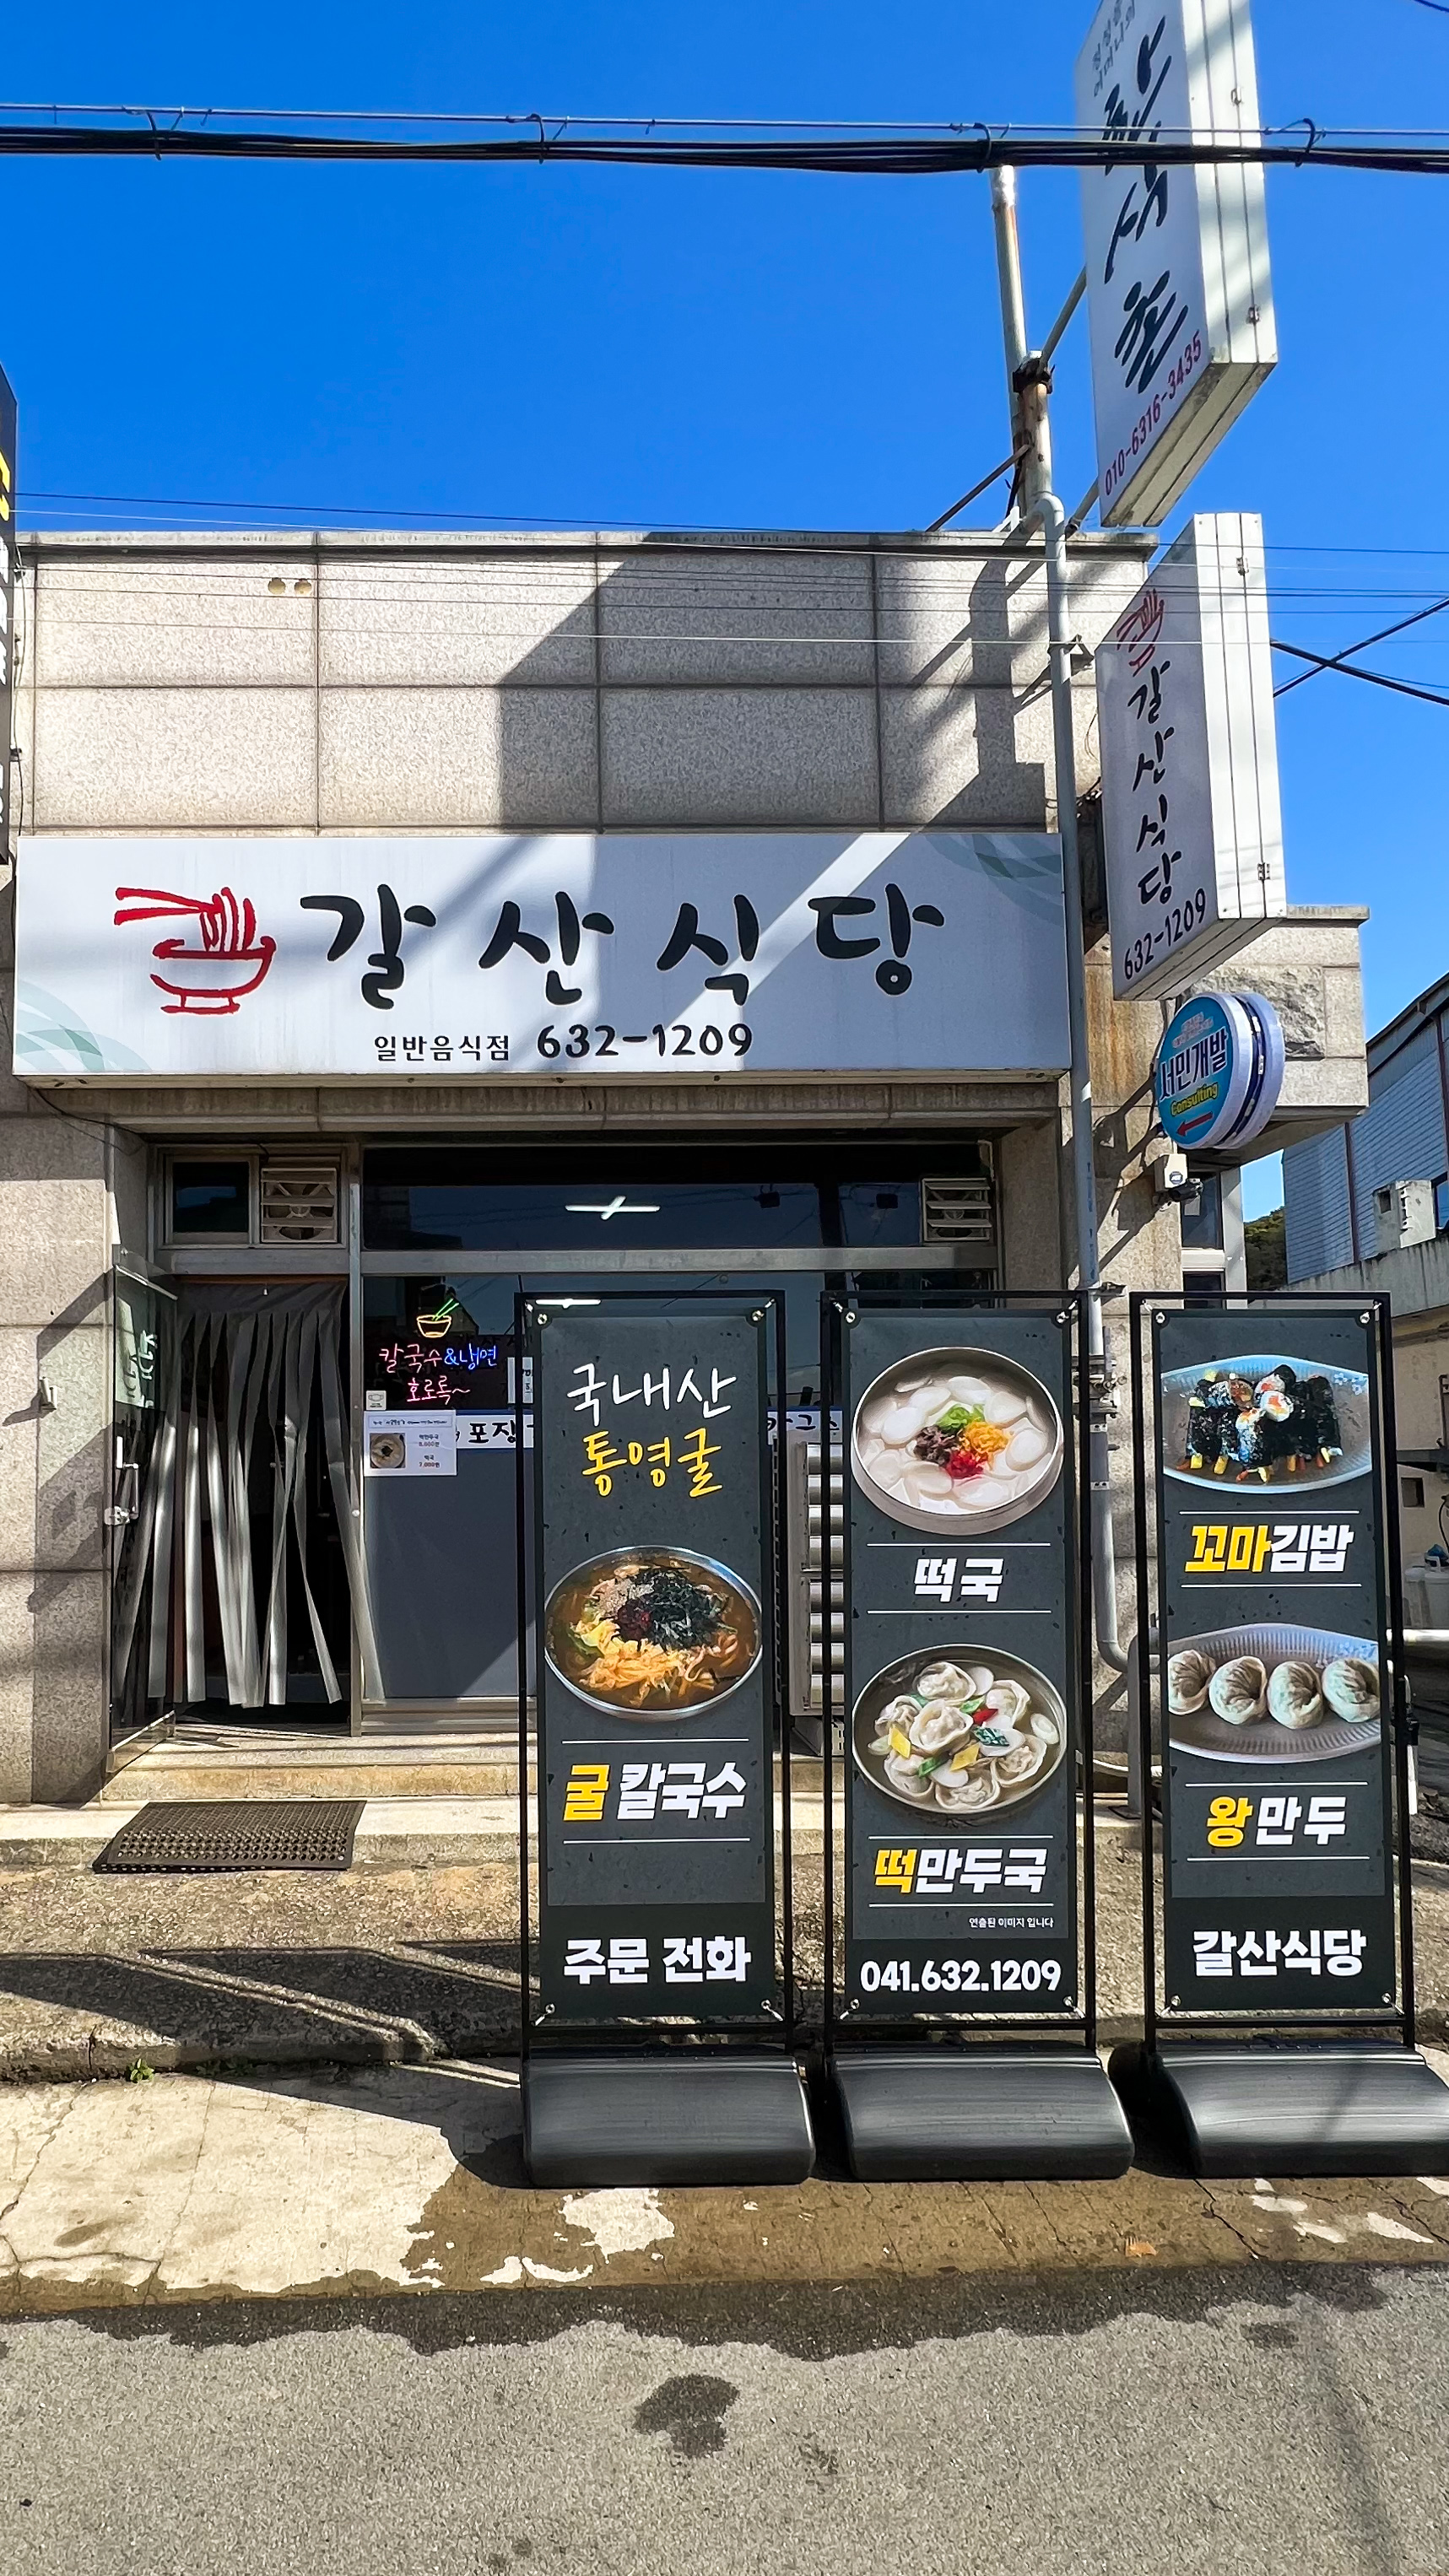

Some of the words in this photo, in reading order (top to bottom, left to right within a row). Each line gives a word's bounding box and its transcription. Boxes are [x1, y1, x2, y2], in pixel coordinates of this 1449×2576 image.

[1105, 328, 1202, 496] 010-6316-3435
[1128, 660, 1182, 905] 갈산식당
[300, 883, 945, 1010] 갈산식당
[1123, 888, 1208, 980] 632-1209
[373, 1034, 511, 1062] 일반음식점
[536, 1023, 754, 1059] 632-1209
[1160, 1026, 1228, 1100] 서민개발
[1171, 1083, 1219, 1117] Consulting
[566, 1363, 737, 1427] 국내산
[582, 1427, 723, 1498] 통영굴
[1184, 1525, 1354, 1573] 꼬마김밥
[914, 1558, 1004, 1603] 떡국
[563, 1763, 611, 1822] 굴
[617, 1761, 748, 1821] 칼국수
[1206, 1796, 1348, 1848] 왕만두
[873, 1848, 1048, 1894] 떡만두국
[969, 1917, 997, 1929] 연출된
[998, 1917, 1025, 1929] 이미지
[1026, 1917, 1054, 1929] 입니다
[563, 1937, 651, 1985] 주문
[662, 1936, 753, 1985] 전화
[859, 1959, 1062, 1992] 041.632.1209
[1192, 1929, 1367, 1977] 갈산식당
